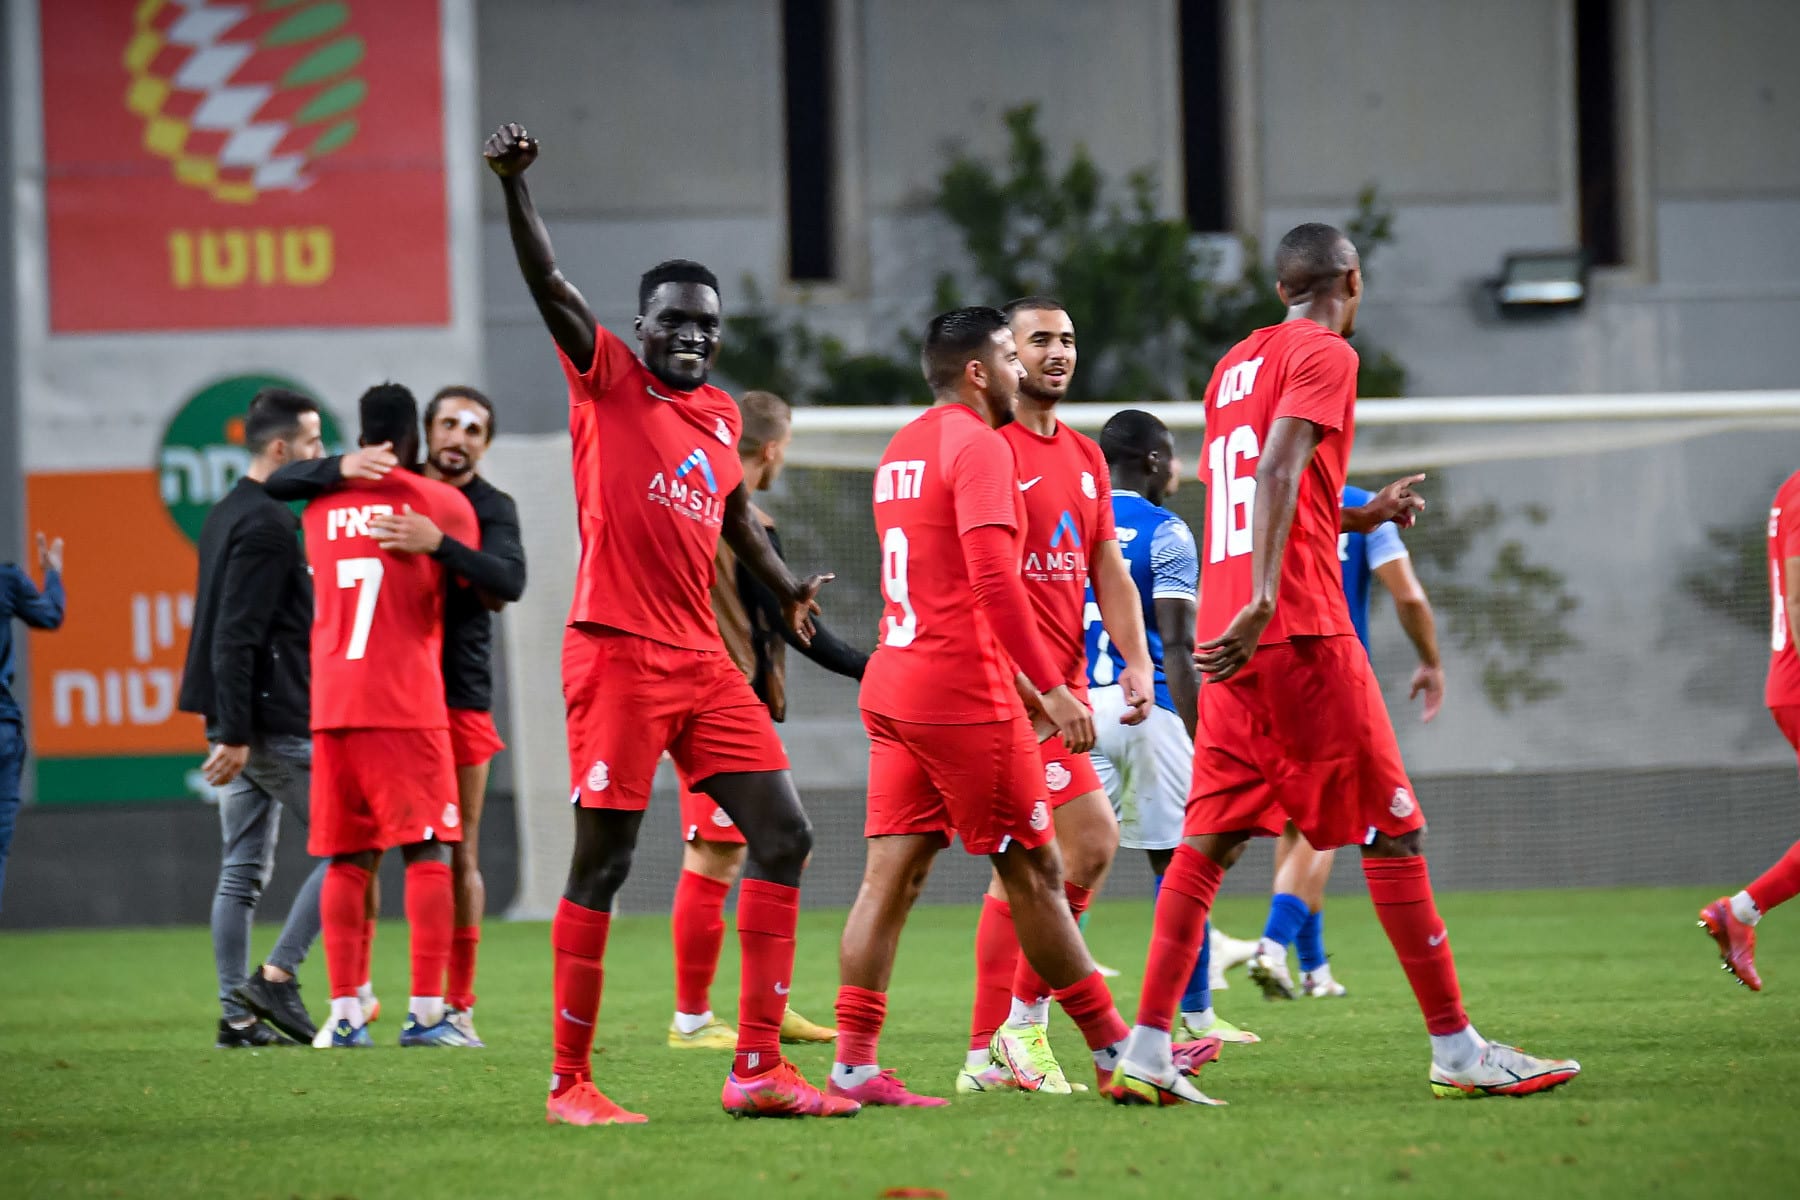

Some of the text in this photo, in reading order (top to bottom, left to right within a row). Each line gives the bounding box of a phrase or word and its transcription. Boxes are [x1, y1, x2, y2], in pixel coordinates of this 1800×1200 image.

[170, 227, 334, 289] טוטו
[648, 472, 721, 523] AMSIL
[1209, 425, 1259, 564] 16
[883, 527, 917, 647] 9
[1025, 552, 1089, 571] AMSIL
[336, 557, 385, 660] 7
